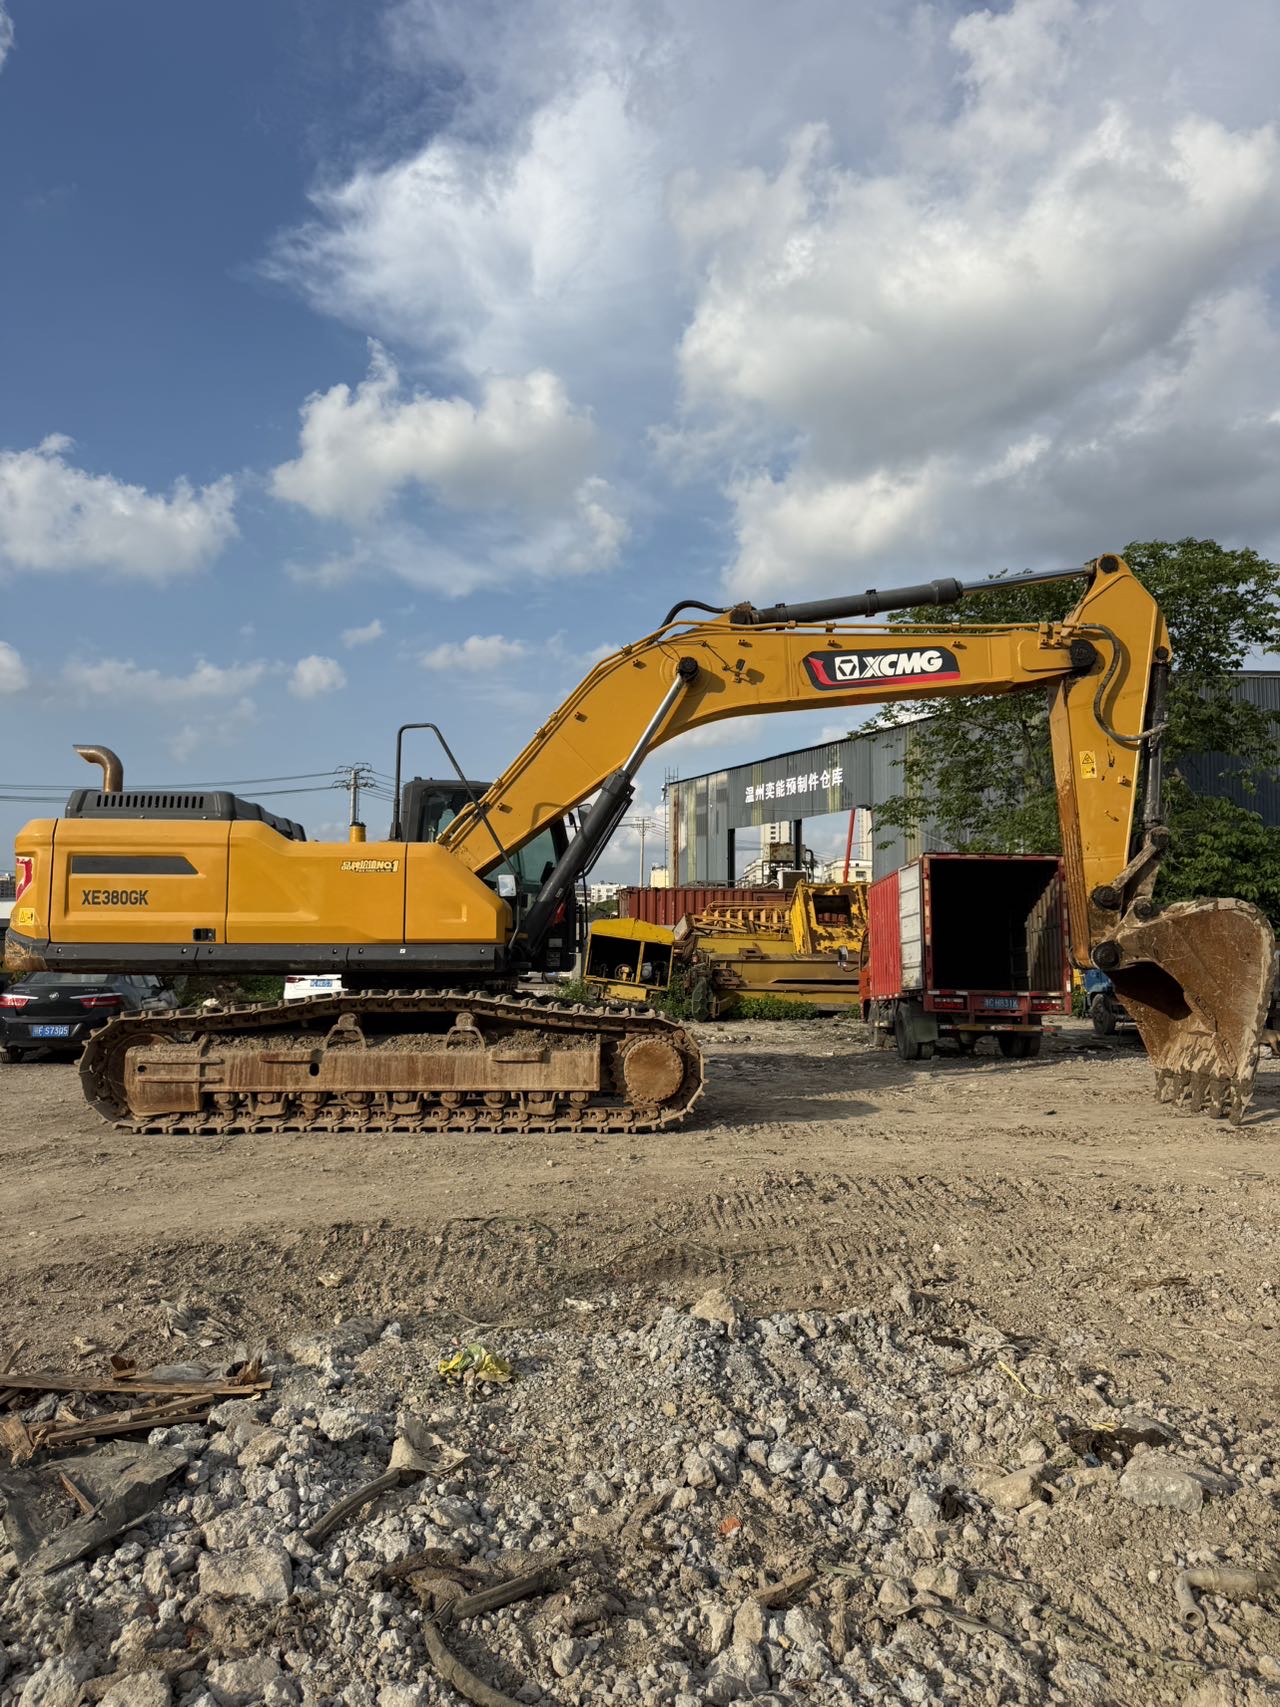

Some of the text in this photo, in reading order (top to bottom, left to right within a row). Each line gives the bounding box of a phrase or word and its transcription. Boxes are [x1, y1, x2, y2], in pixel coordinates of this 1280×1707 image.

[860, 650, 943, 678] XCMG
[745, 767, 843, 803] 温州奕能预制件仓库
[82, 889, 149, 906] XE380GK
